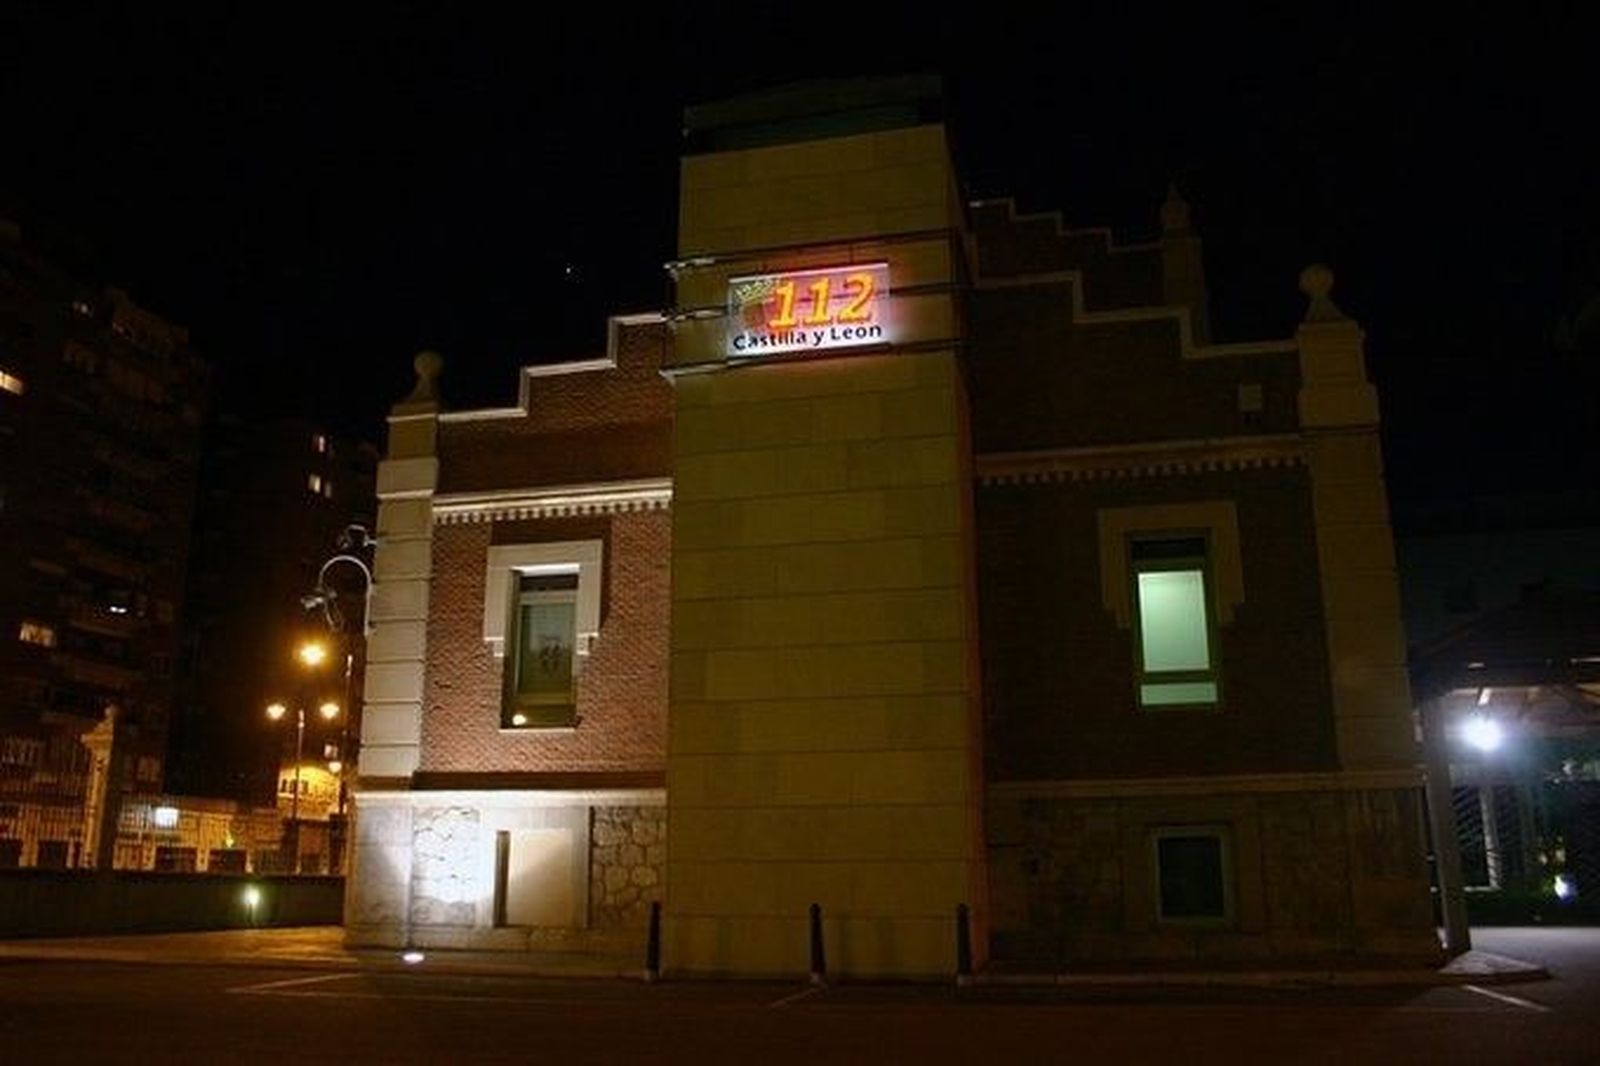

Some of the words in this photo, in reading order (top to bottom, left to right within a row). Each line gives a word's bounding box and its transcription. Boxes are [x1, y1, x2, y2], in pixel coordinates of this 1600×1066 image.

[767, 272, 876, 328] 112
[733, 330, 807, 350] Castilla
[813, 331, 825, 346] y
